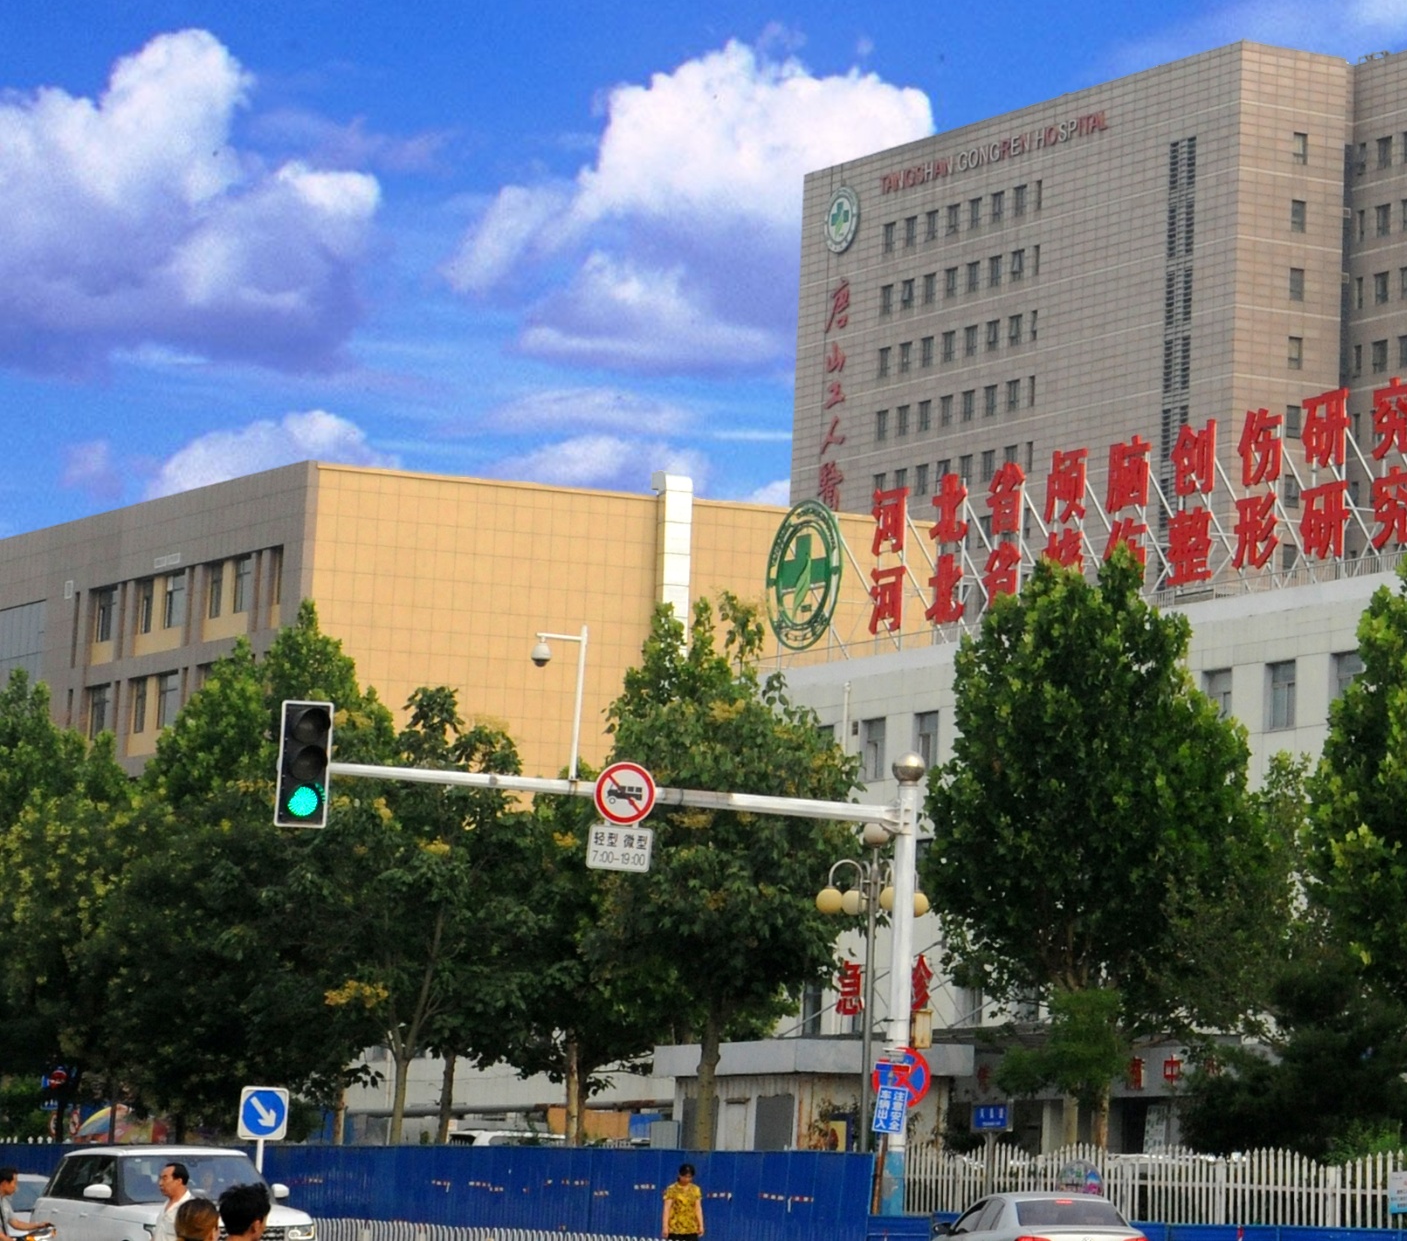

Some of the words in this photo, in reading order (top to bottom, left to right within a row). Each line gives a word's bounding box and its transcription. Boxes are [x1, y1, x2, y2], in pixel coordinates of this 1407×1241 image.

[879, 156, 954, 196] TANGSHAN
[956, 133, 1032, 173] GONGREN
[1034, 110, 1109, 151] HOSPITAL
[592, 849, 646, 867] 7:00-19:00
